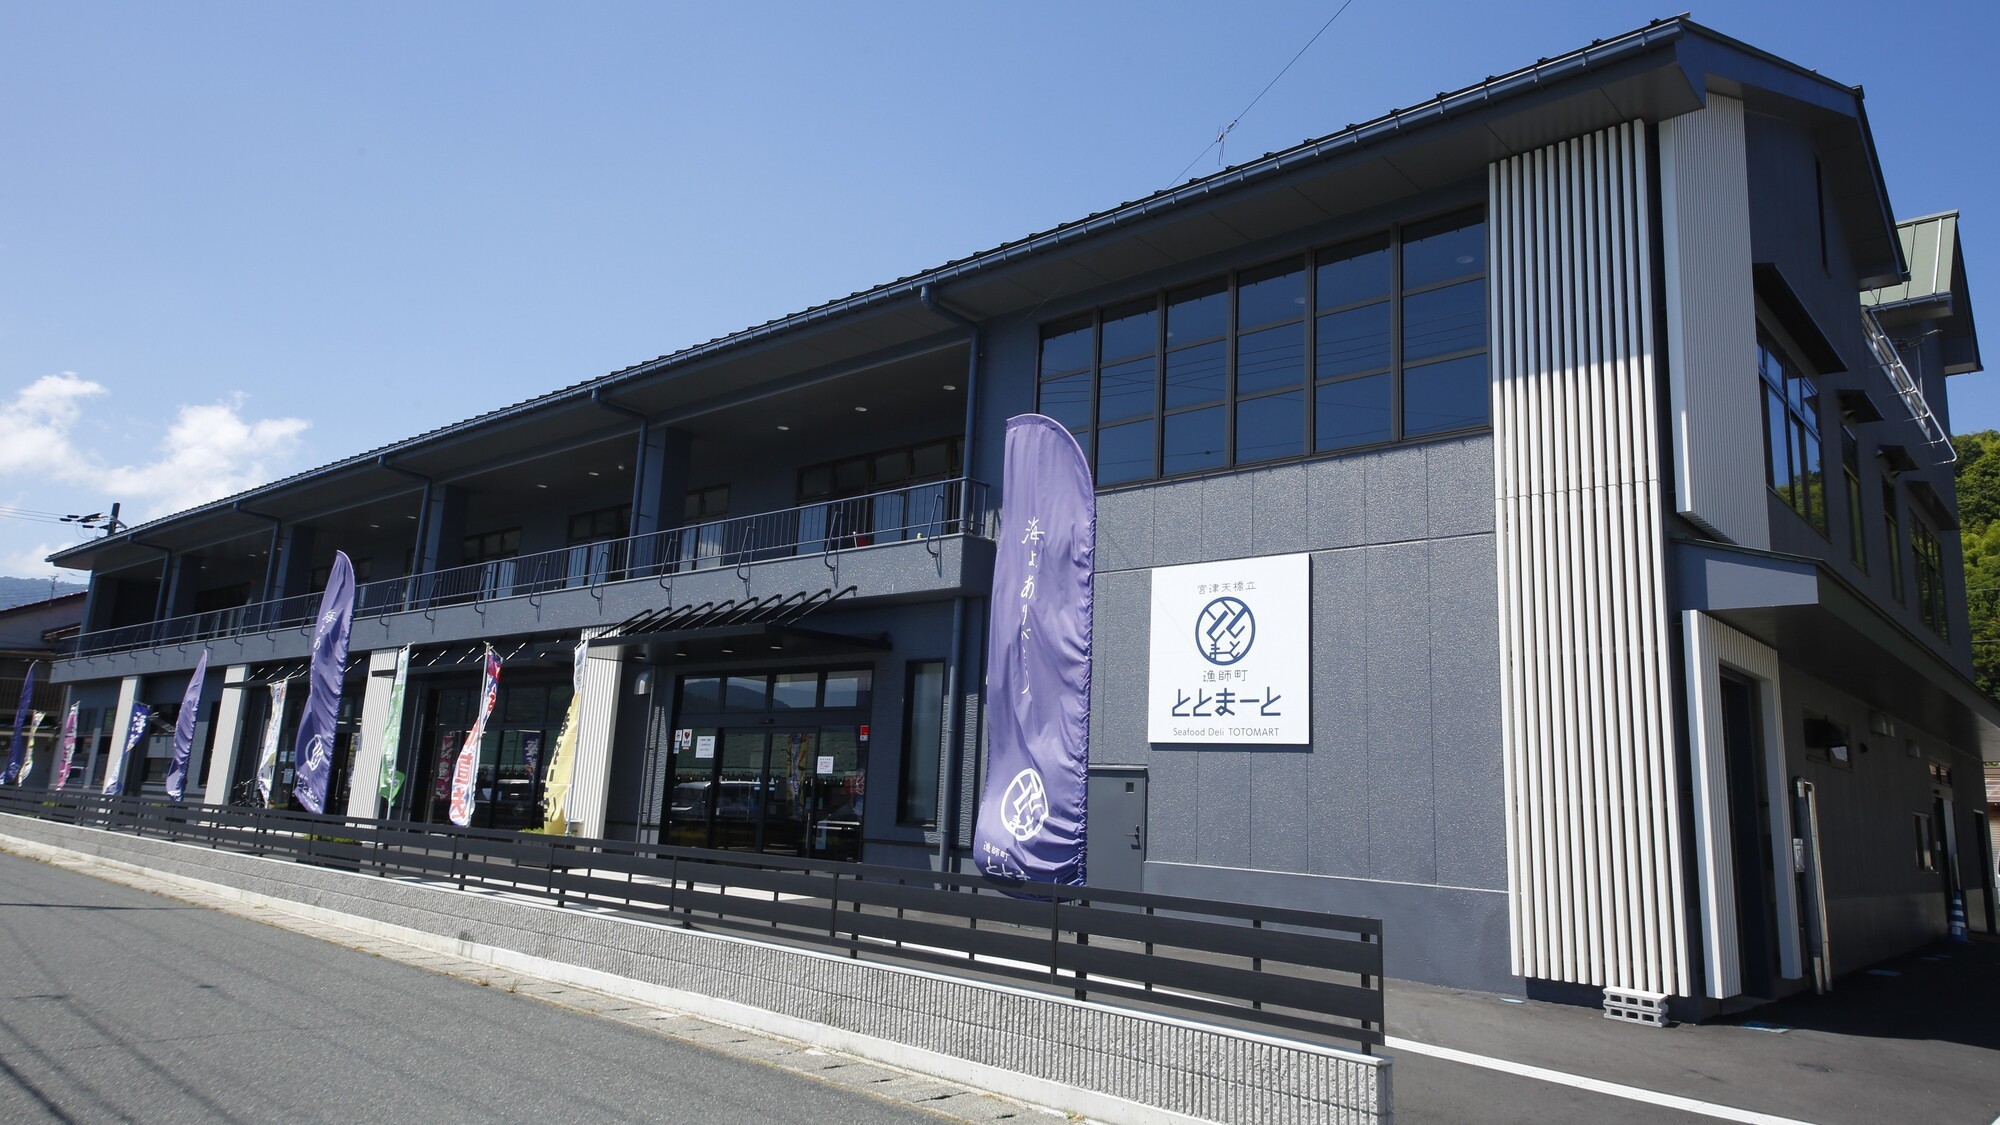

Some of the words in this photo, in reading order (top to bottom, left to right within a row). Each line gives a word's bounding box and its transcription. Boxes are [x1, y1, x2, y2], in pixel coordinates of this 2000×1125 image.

[1197, 581, 1257, 595] 宮津天橋立
[1202, 669, 1249, 683] 漁師町
[1171, 686, 1282, 717] ととまーと
[1172, 727, 1206, 737] Seafood
[1208, 727, 1225, 737] Deli
[1228, 727, 1280, 737] TOTOMART
